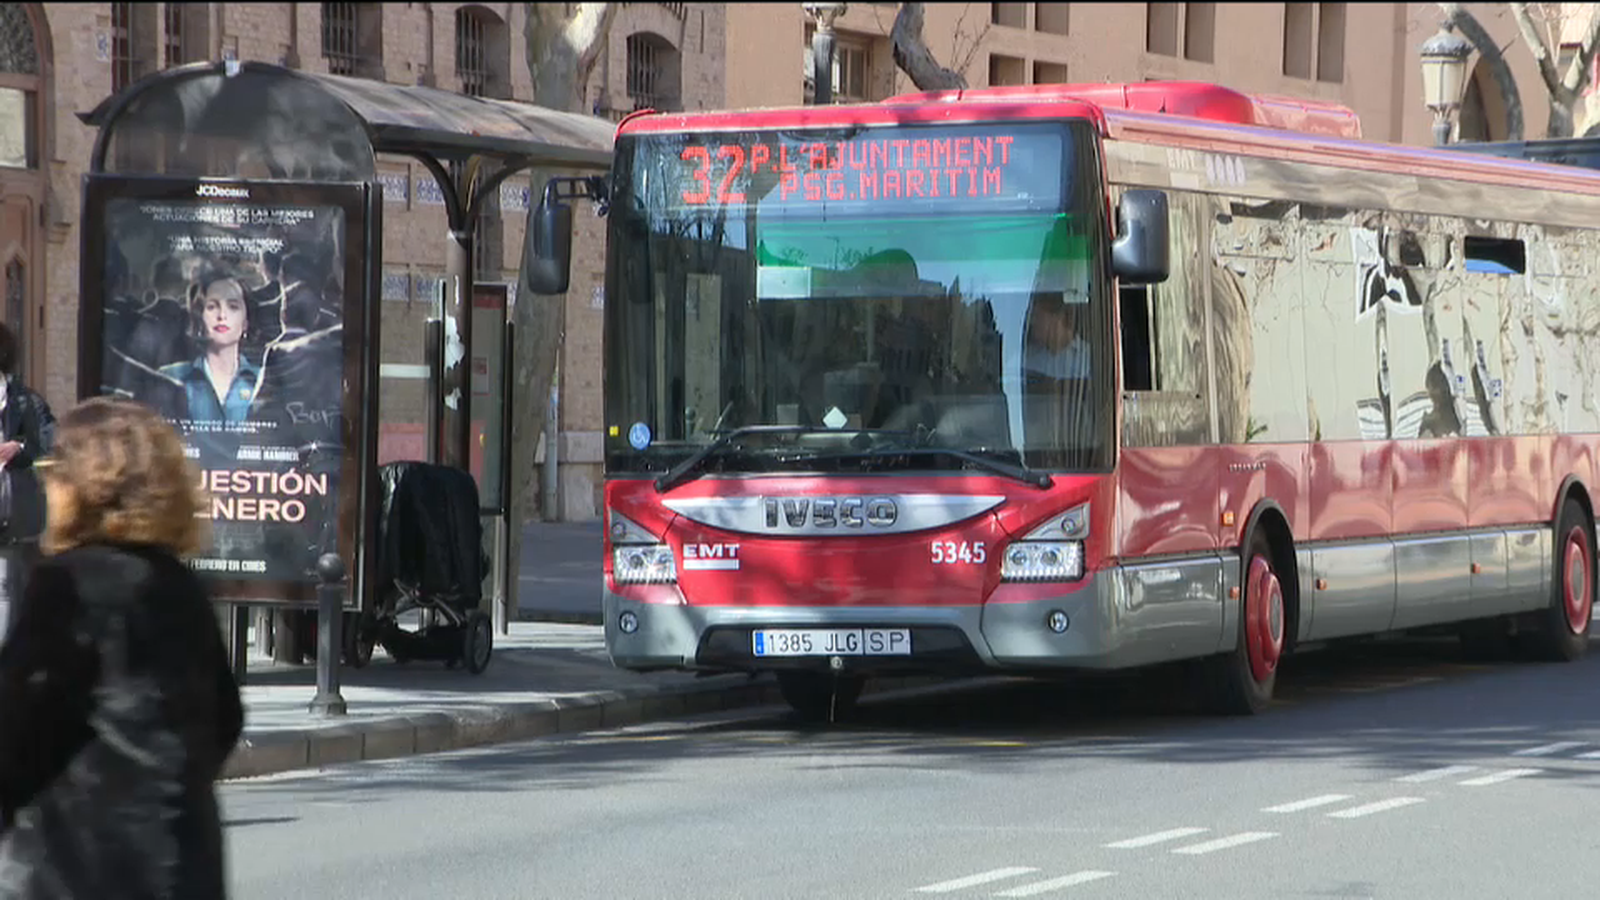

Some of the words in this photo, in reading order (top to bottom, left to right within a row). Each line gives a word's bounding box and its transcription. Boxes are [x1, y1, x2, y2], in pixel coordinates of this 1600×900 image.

[680, 144, 747, 205] 32
[779, 166, 1003, 202] PSG.MARITIM
[195, 184, 250, 198] JCDecaux
[196, 467, 328, 496] UESTIÓN
[765, 497, 898, 528] IVECO
[683, 543, 740, 558] EMT
[930, 541, 987, 564] 5345
[767, 632, 812, 653] 1385
[824, 632, 858, 653] JLG
